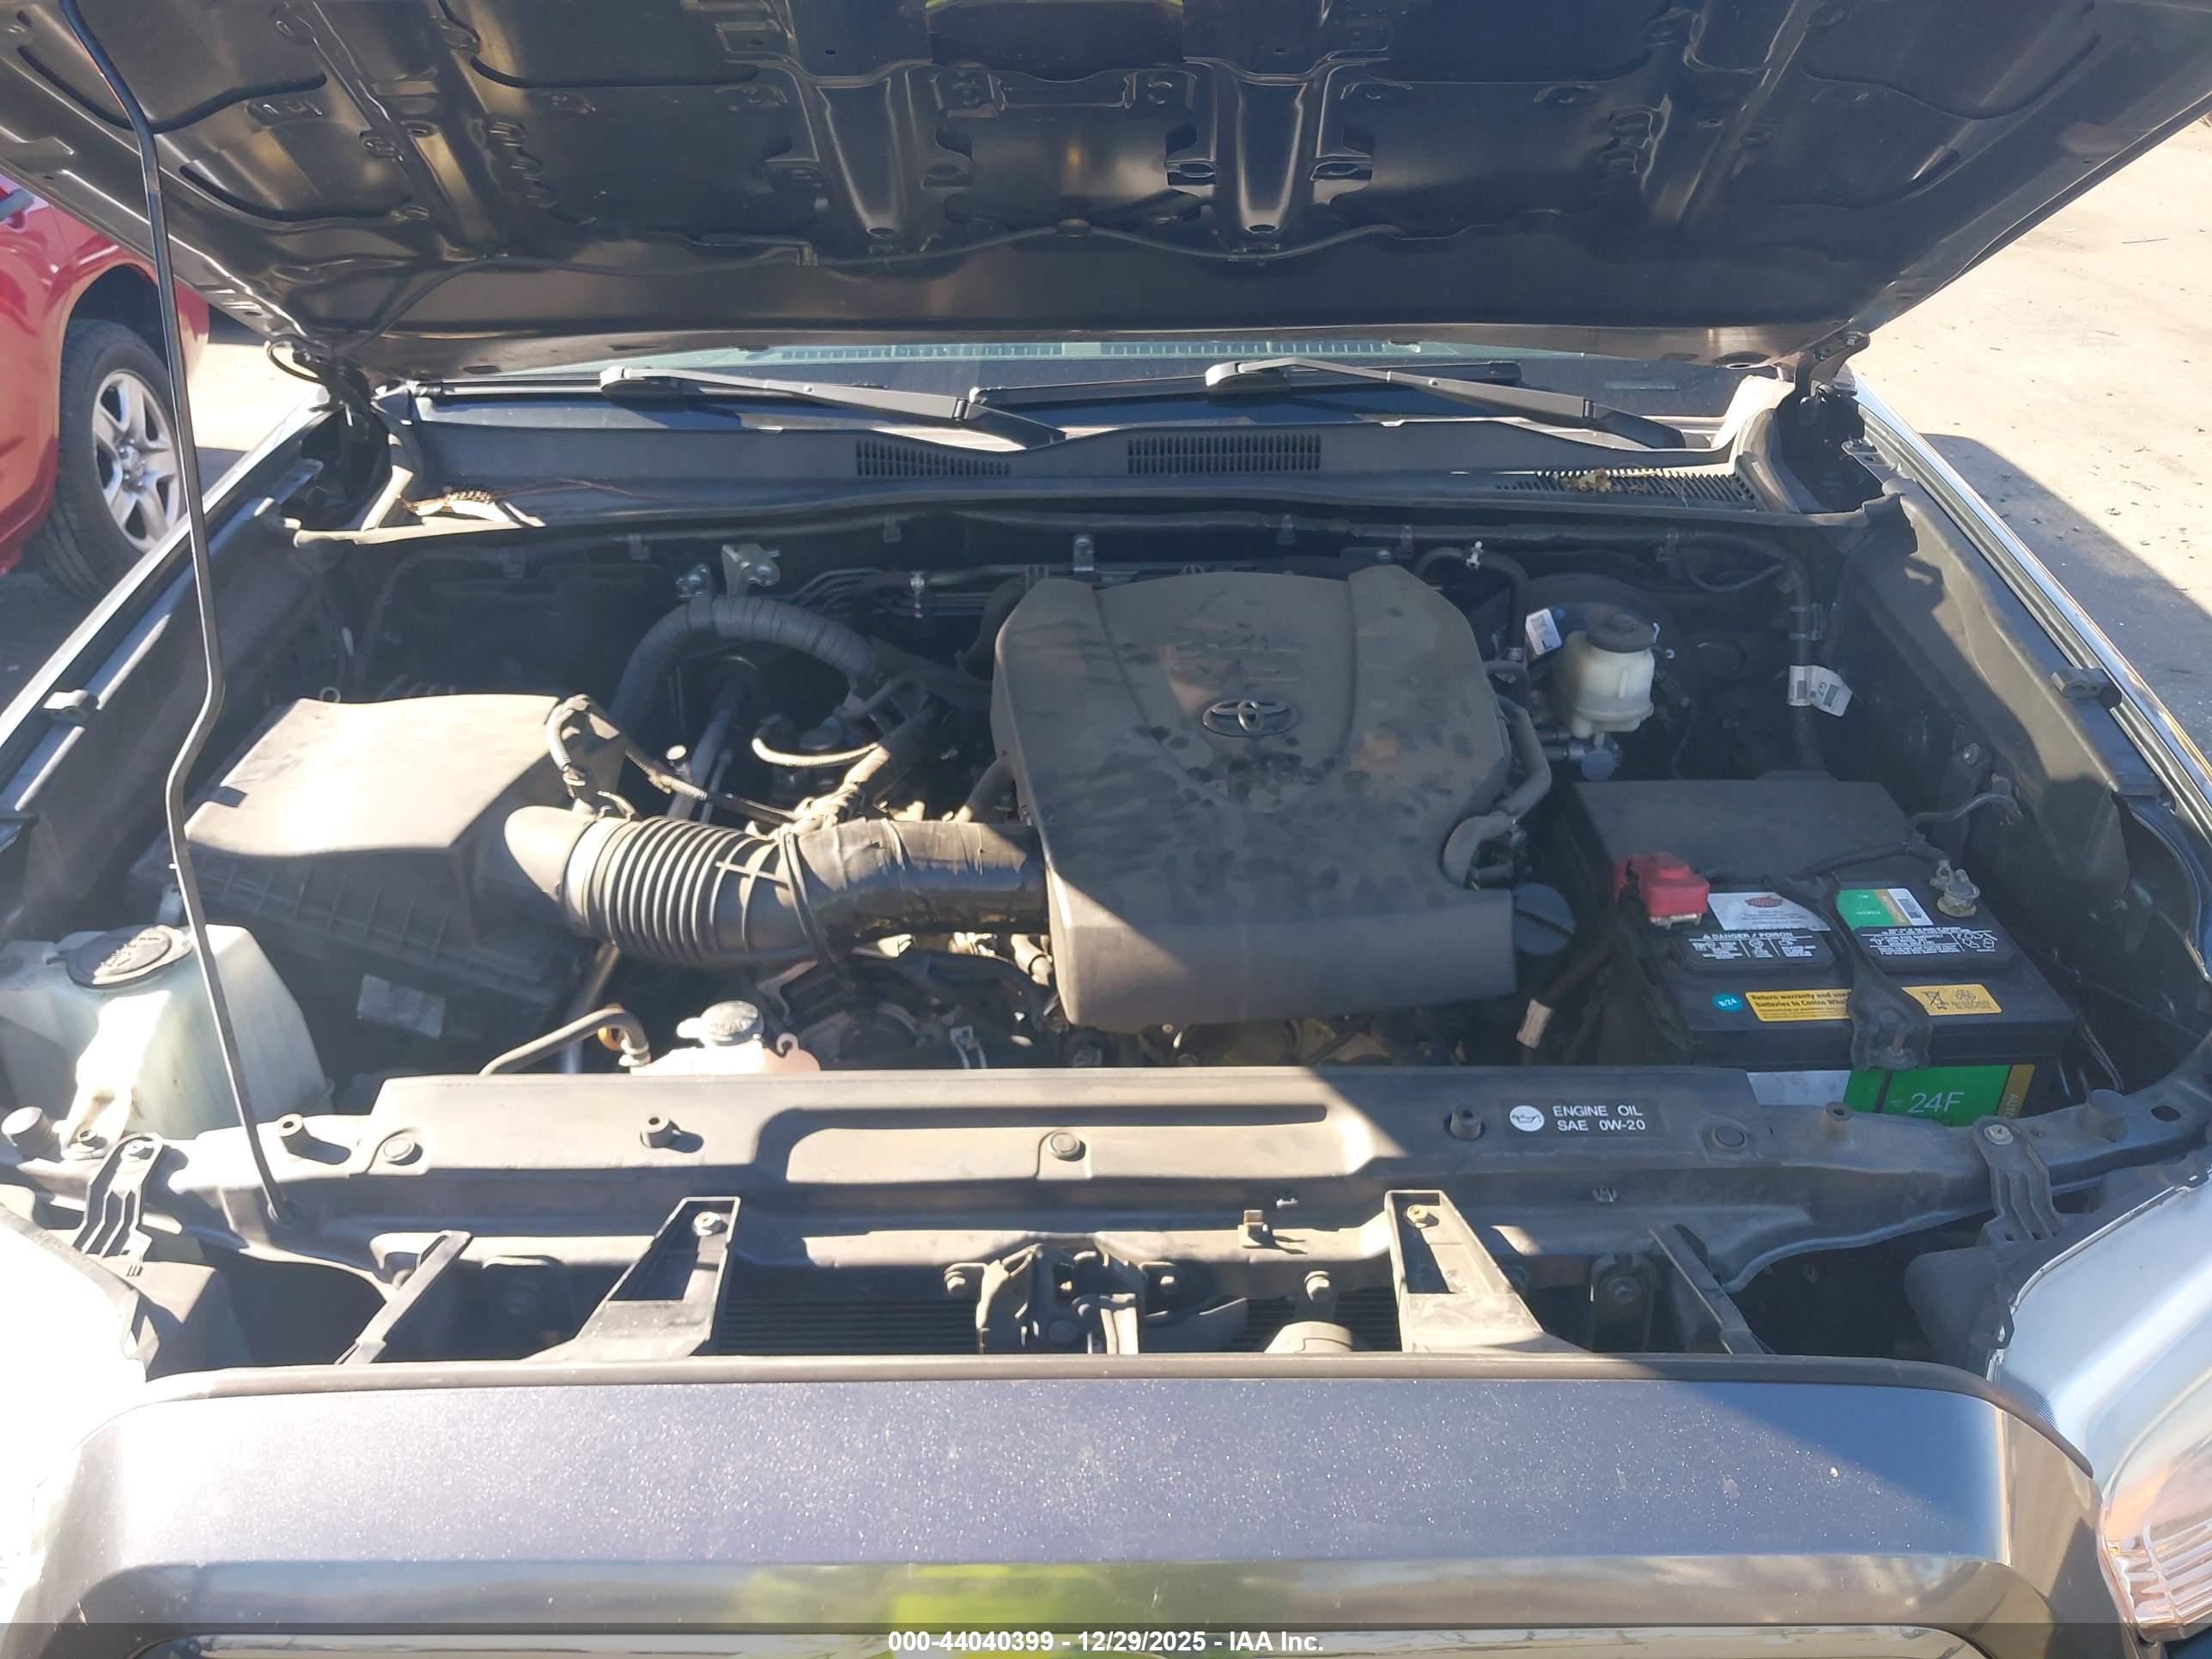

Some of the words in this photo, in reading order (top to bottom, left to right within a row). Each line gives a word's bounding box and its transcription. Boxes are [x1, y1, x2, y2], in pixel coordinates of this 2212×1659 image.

[1908, 1092, 1966, 1114] 24F
[1553, 1105, 1608, 1117] ENGINE
[1617, 1105, 1643, 1116] OIL
[1557, 1120, 1589, 1131] SAE
[1599, 1119, 1646, 1131] 0W-20
